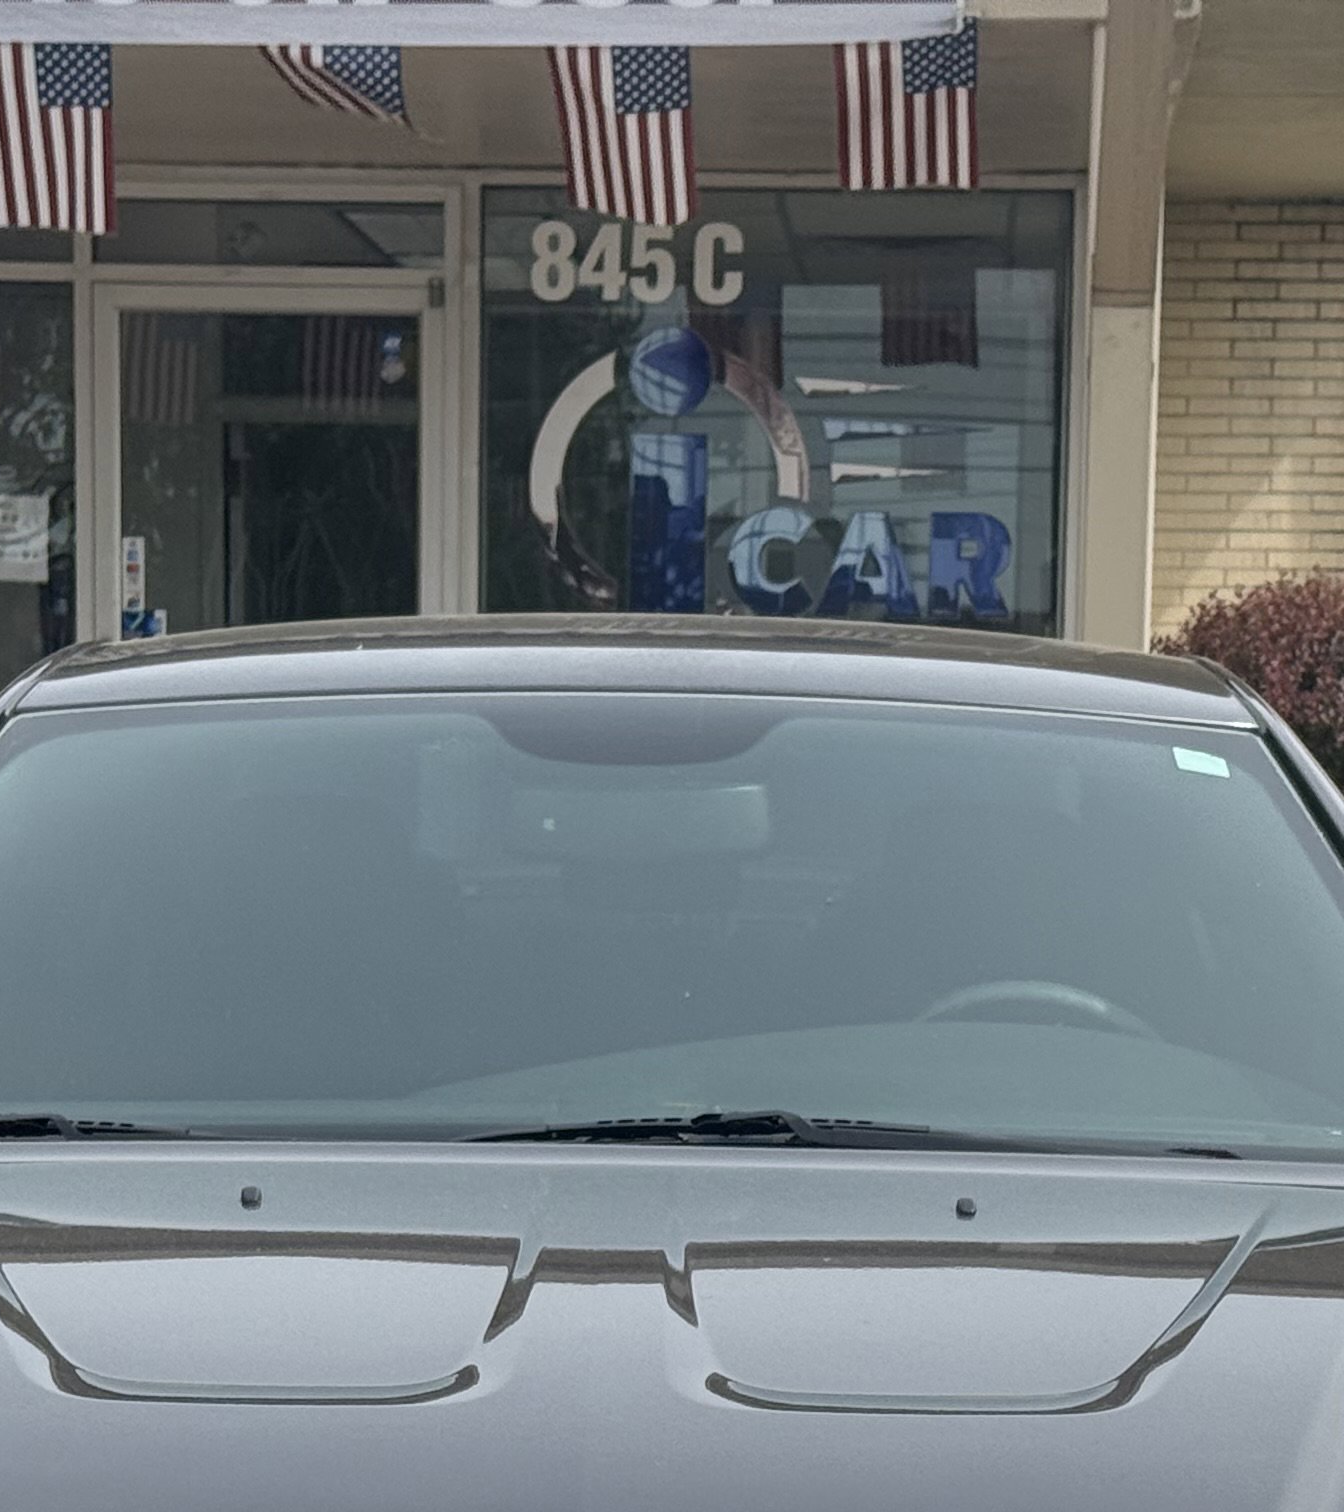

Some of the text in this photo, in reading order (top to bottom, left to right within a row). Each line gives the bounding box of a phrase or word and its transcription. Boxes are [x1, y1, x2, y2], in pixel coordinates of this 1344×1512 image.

[530, 222, 744, 305] 845 C
[727, 507, 1011, 618] CAR
